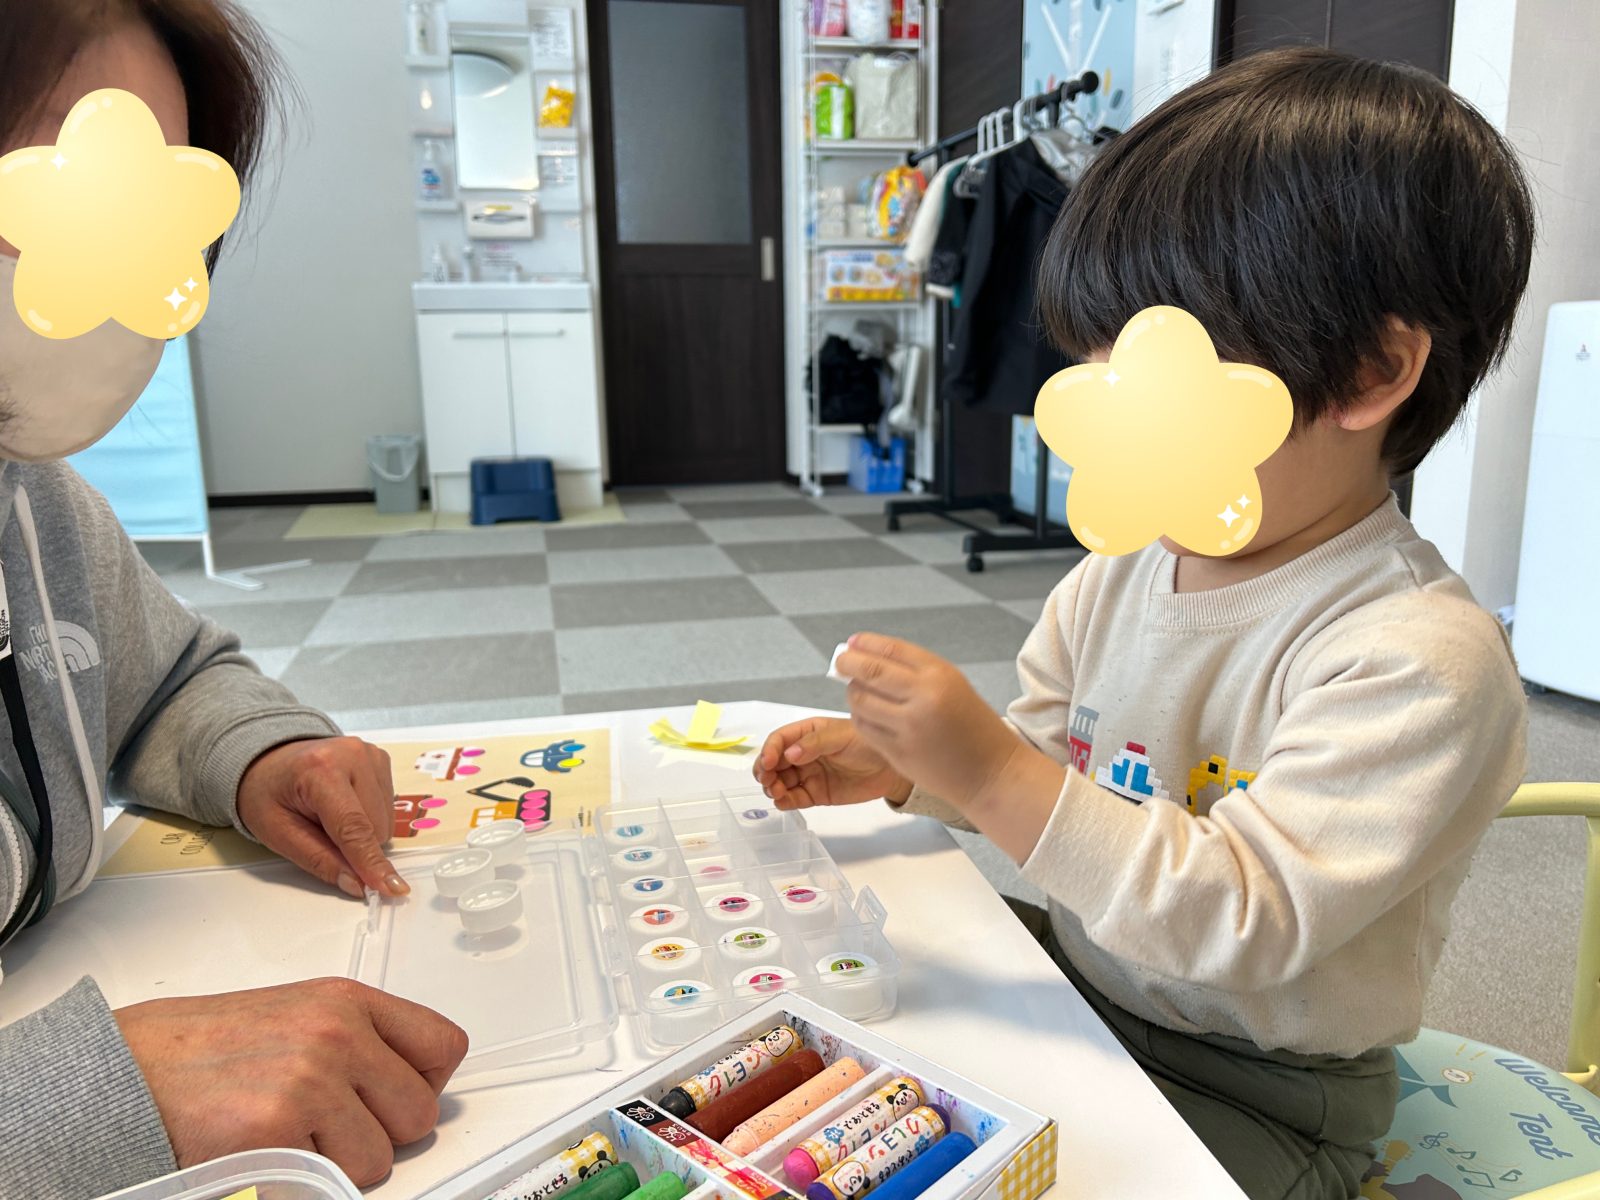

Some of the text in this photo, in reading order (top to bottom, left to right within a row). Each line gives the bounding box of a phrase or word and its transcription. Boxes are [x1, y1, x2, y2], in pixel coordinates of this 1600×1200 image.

[709, 1052, 761, 1097] クレヨン
[868, 1117, 920, 1161] クレヨン
[1509, 1112, 1574, 1160] Tent
